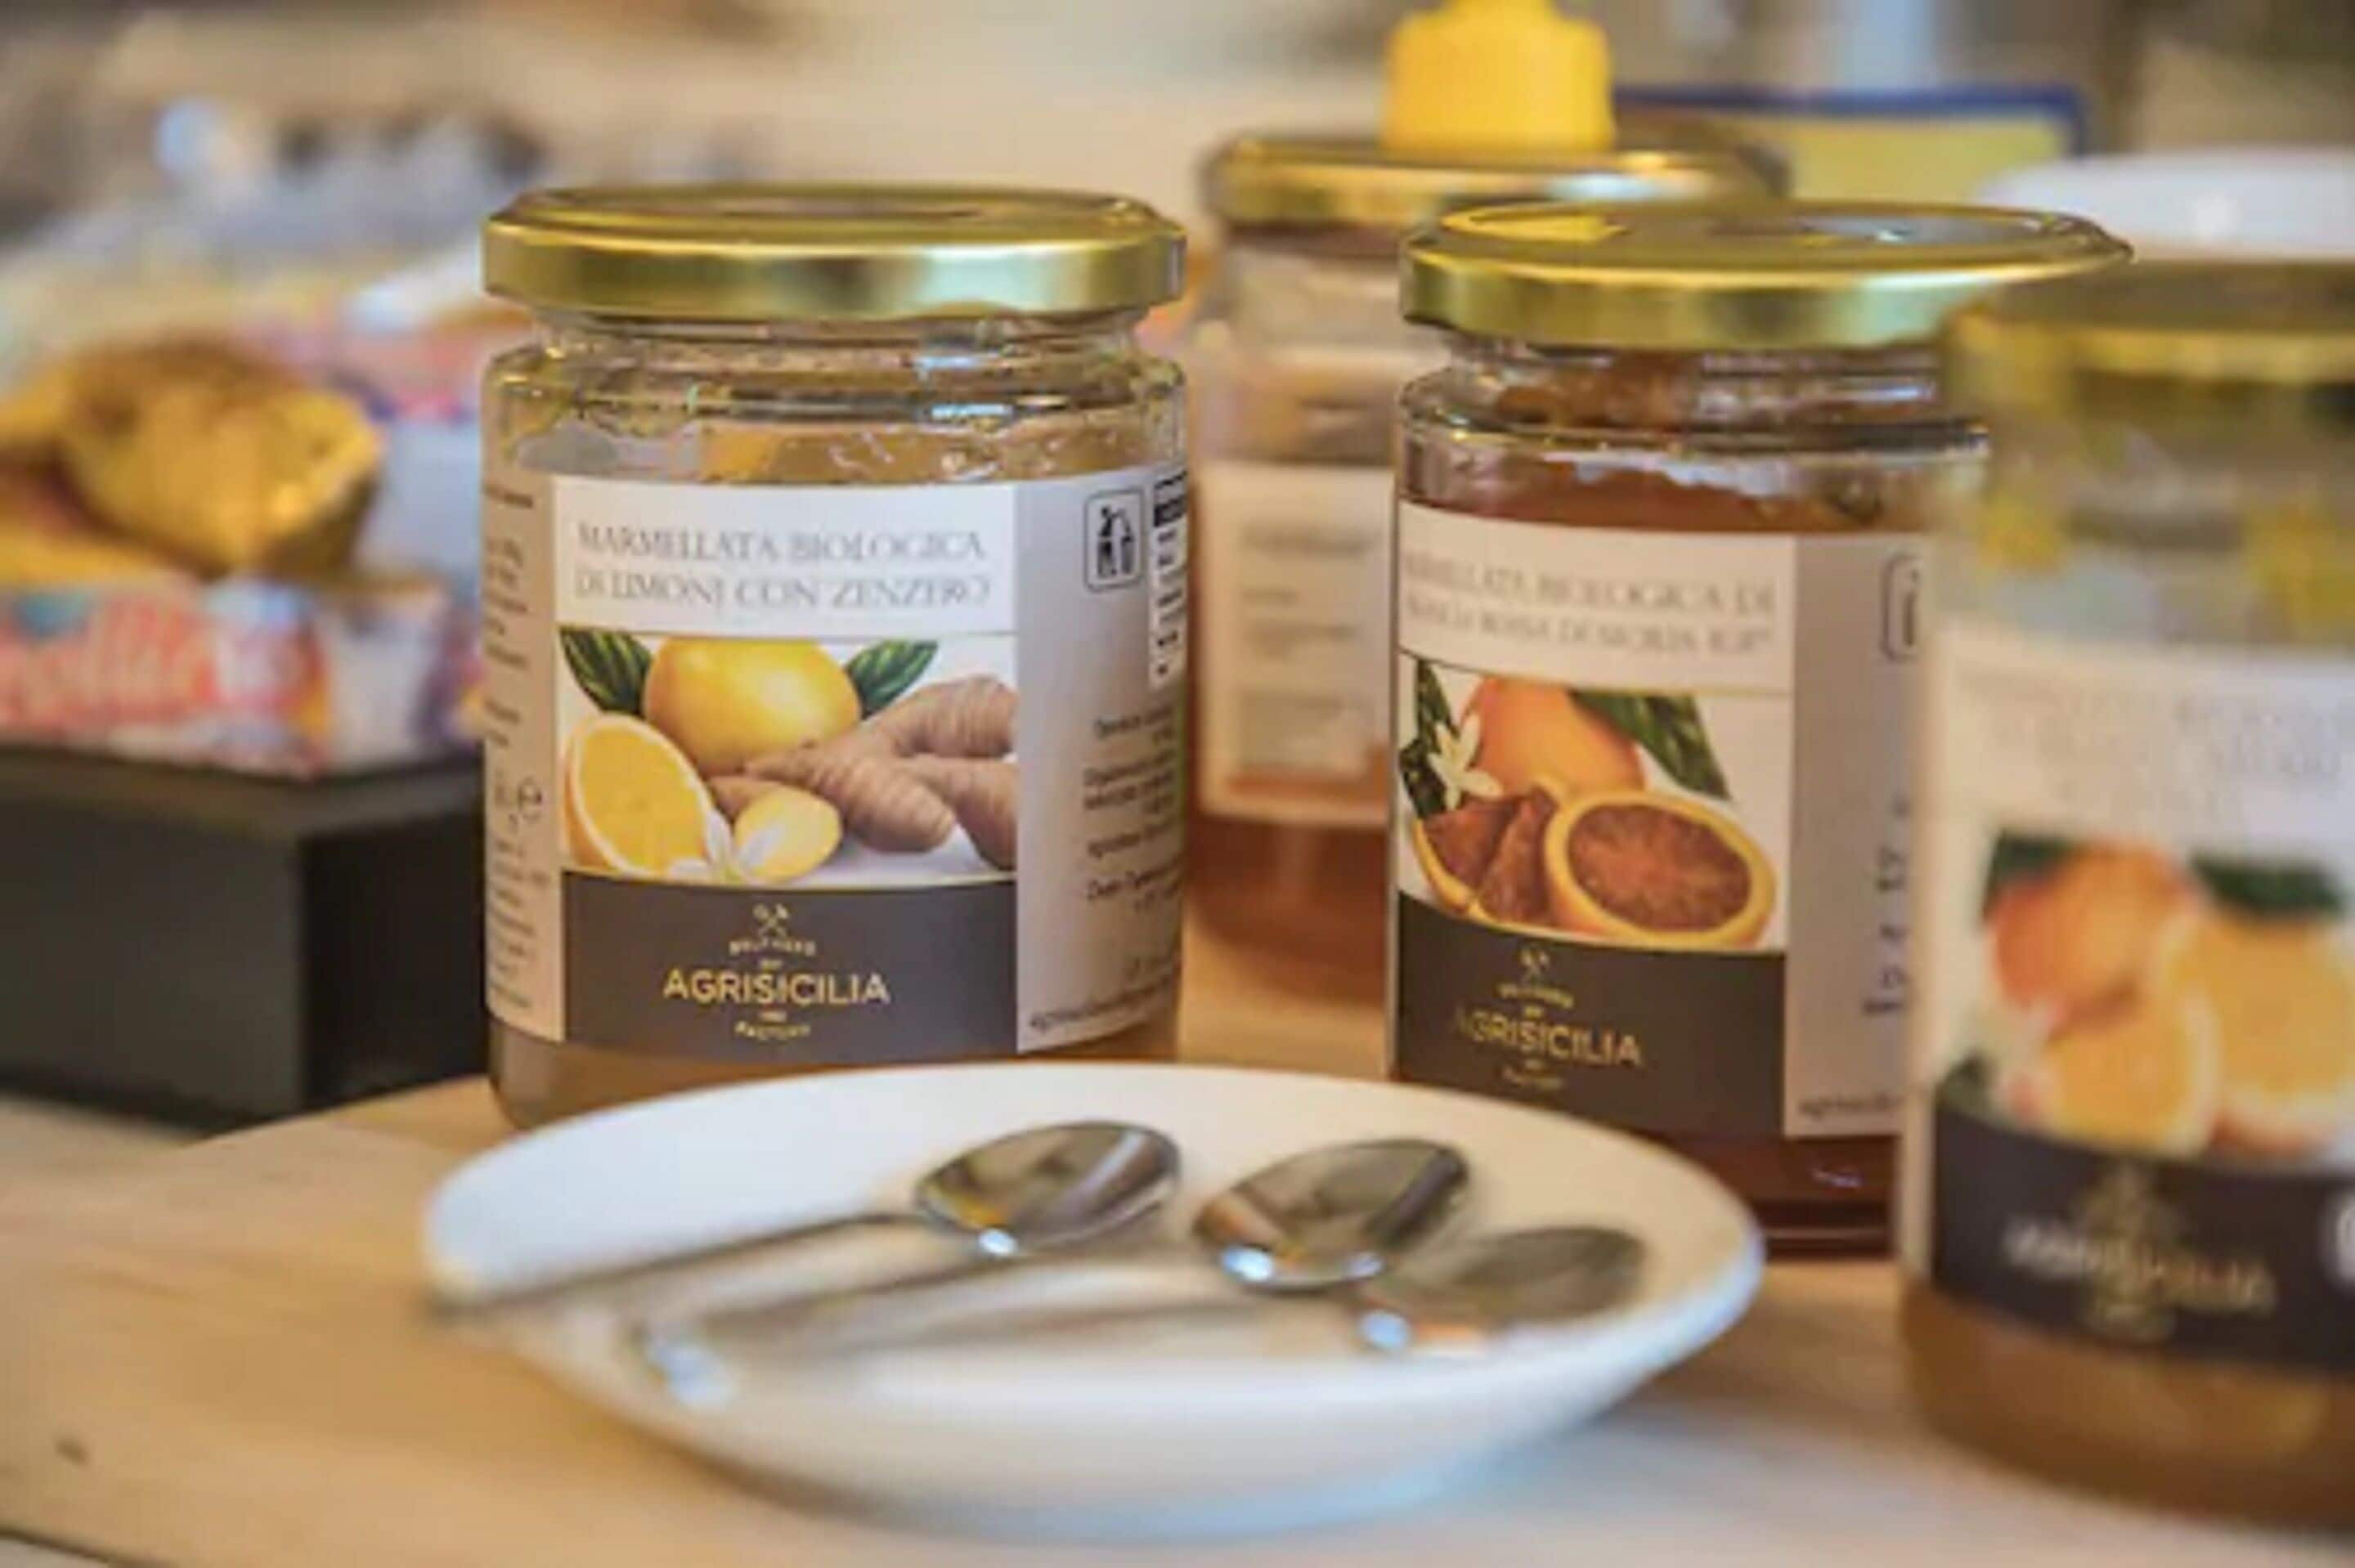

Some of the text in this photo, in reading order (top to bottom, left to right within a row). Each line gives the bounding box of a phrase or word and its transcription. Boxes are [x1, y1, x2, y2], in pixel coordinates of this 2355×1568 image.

[577, 522, 986, 562] MARMELLATA BIOLOGICA
[575, 570, 992, 610] DI LIMONI CON ZENZERO
[662, 970, 891, 1007] AGRISICILIA
